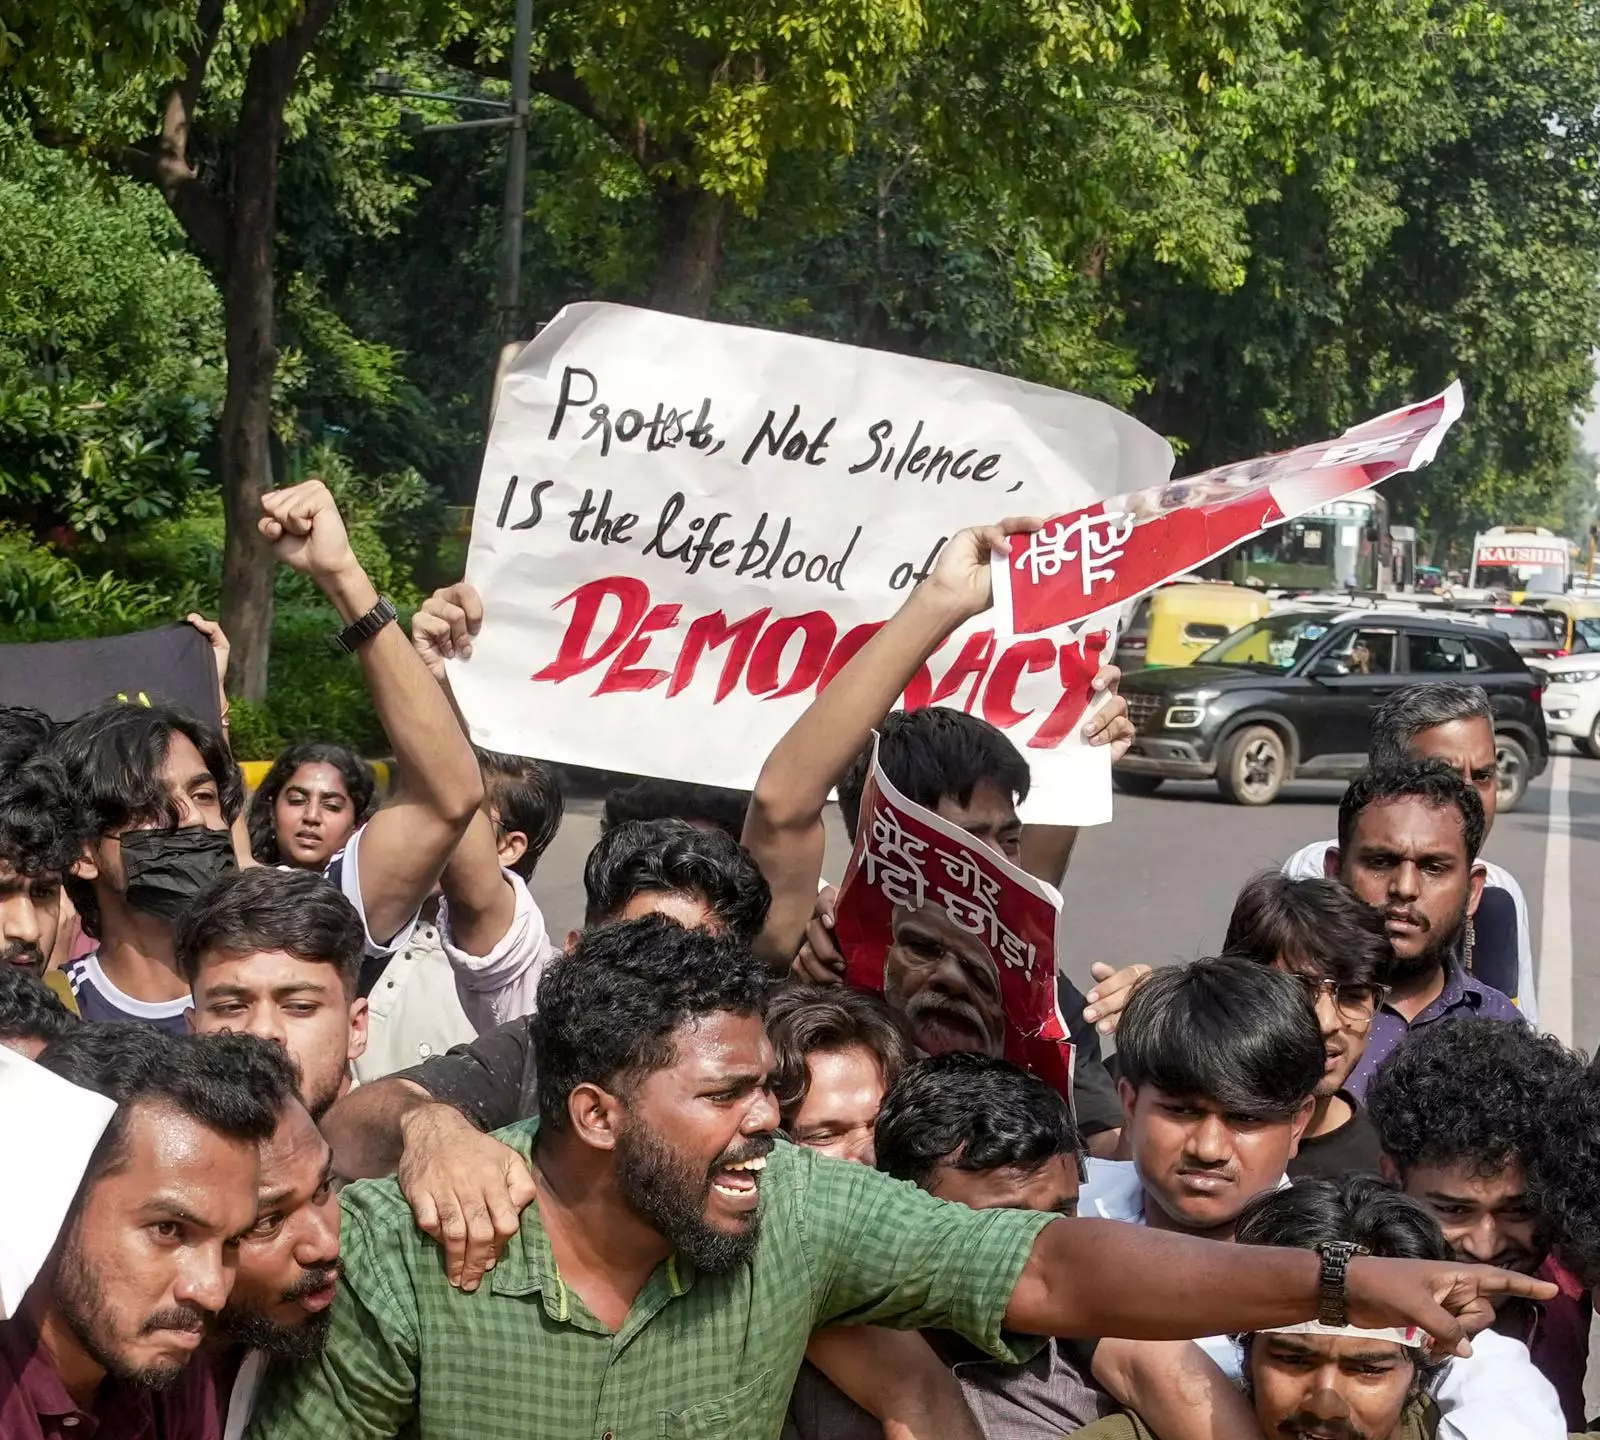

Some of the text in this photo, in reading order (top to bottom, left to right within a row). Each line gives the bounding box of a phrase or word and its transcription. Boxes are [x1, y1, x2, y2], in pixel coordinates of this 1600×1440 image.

[741, 404, 837, 466] Not
[848, 419, 1024, 493] Silence,
[568, 489, 639, 546] the
[1479, 547, 1564, 564] KAUSHIK
[872, 806, 1002, 906] वोट चोर
